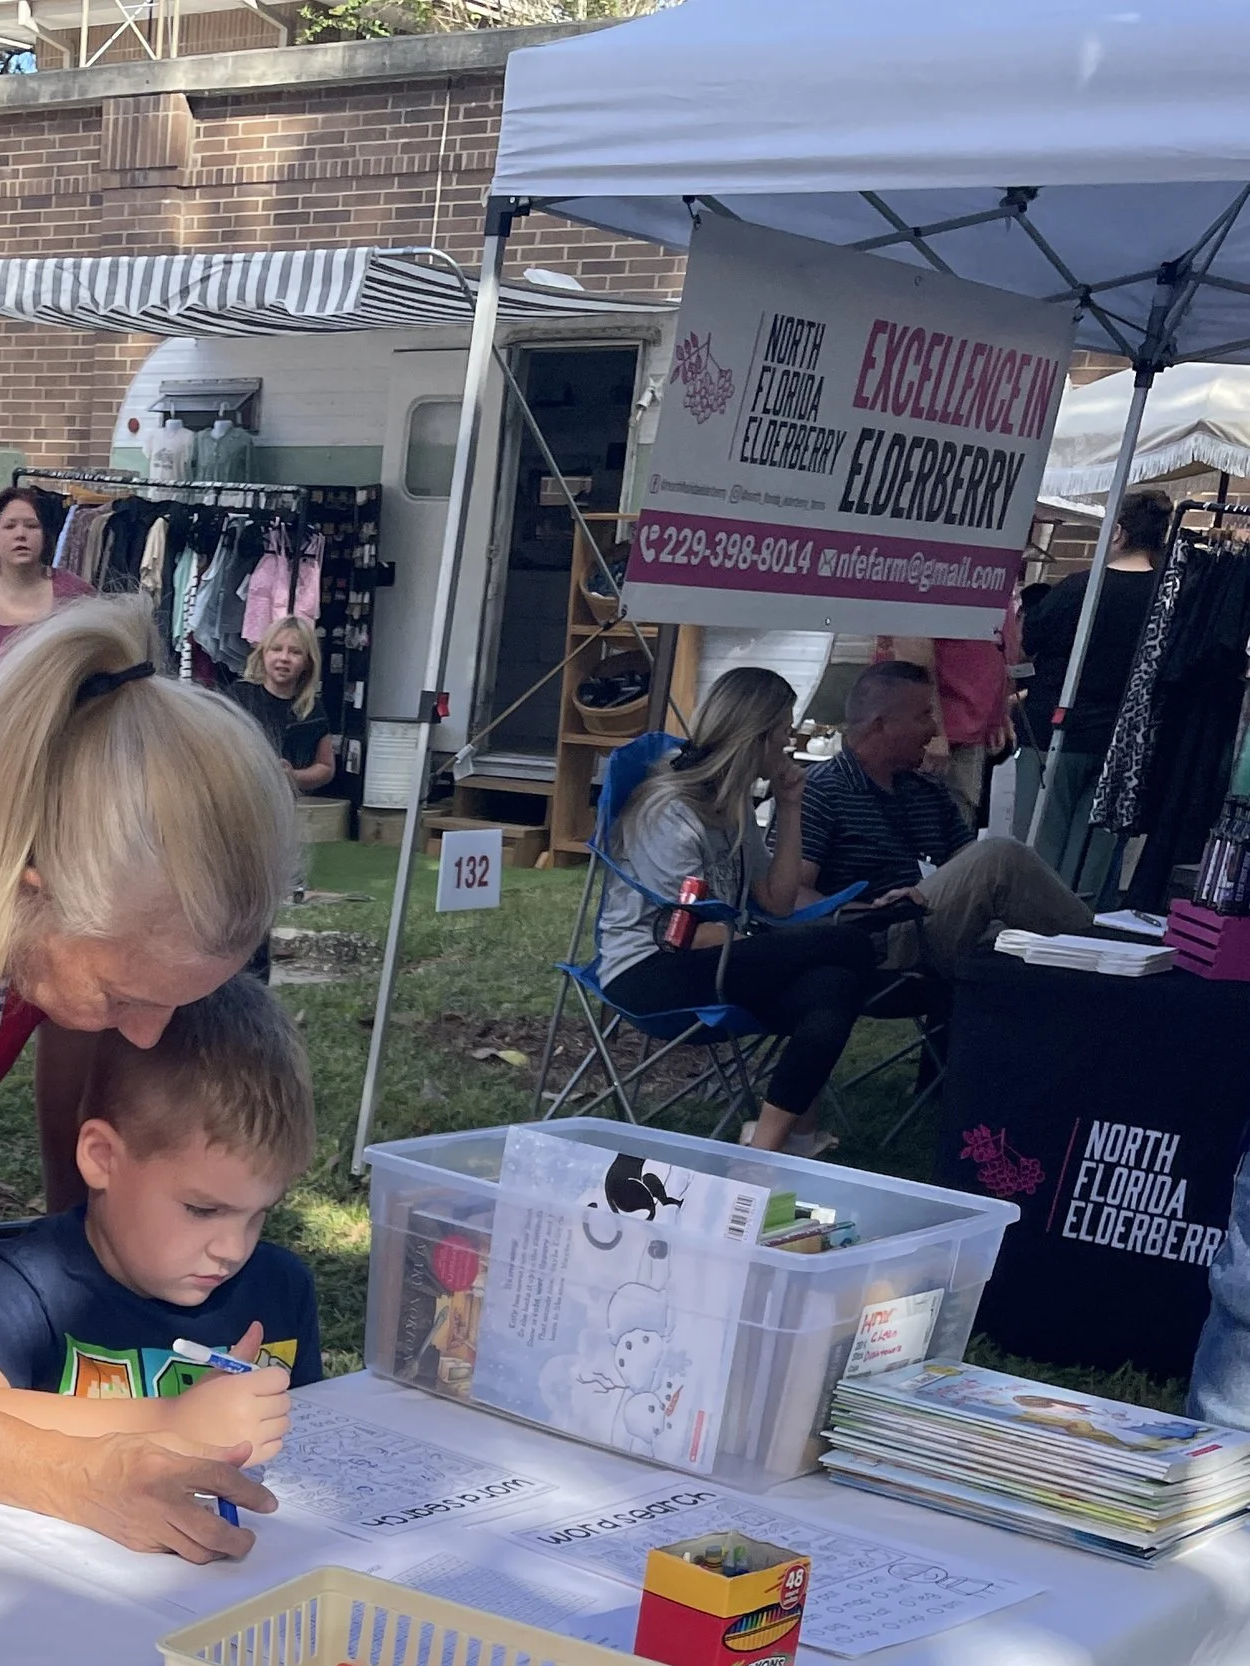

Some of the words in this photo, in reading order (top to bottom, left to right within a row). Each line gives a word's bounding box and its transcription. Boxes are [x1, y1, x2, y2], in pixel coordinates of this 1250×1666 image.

[764, 313, 826, 370] NORTH
[750, 365, 825, 422] FLORIDA
[852, 319, 1033, 435] EXCELLENCE
[1018, 356, 1059, 440] IN
[739, 416, 847, 475] ELDERBERRY
[838, 426, 1026, 530] ELDERBERRY
[658, 525, 814, 575] 229-398-8014
[835, 545, 1007, 592] nfefarm@gmail.com
[452, 855, 491, 890] 132
[1083, 1120, 1181, 1174] NORTH
[1072, 1160, 1188, 1219] FLORIDA
[1061, 1200, 1229, 1268] ELDERBERR
[360, 1498, 466, 1529] search
[455, 1476, 535, 1510] word
[537, 1515, 620, 1546] word
[613, 1489, 717, 1526] search
[785, 1568, 804, 1589] 48
